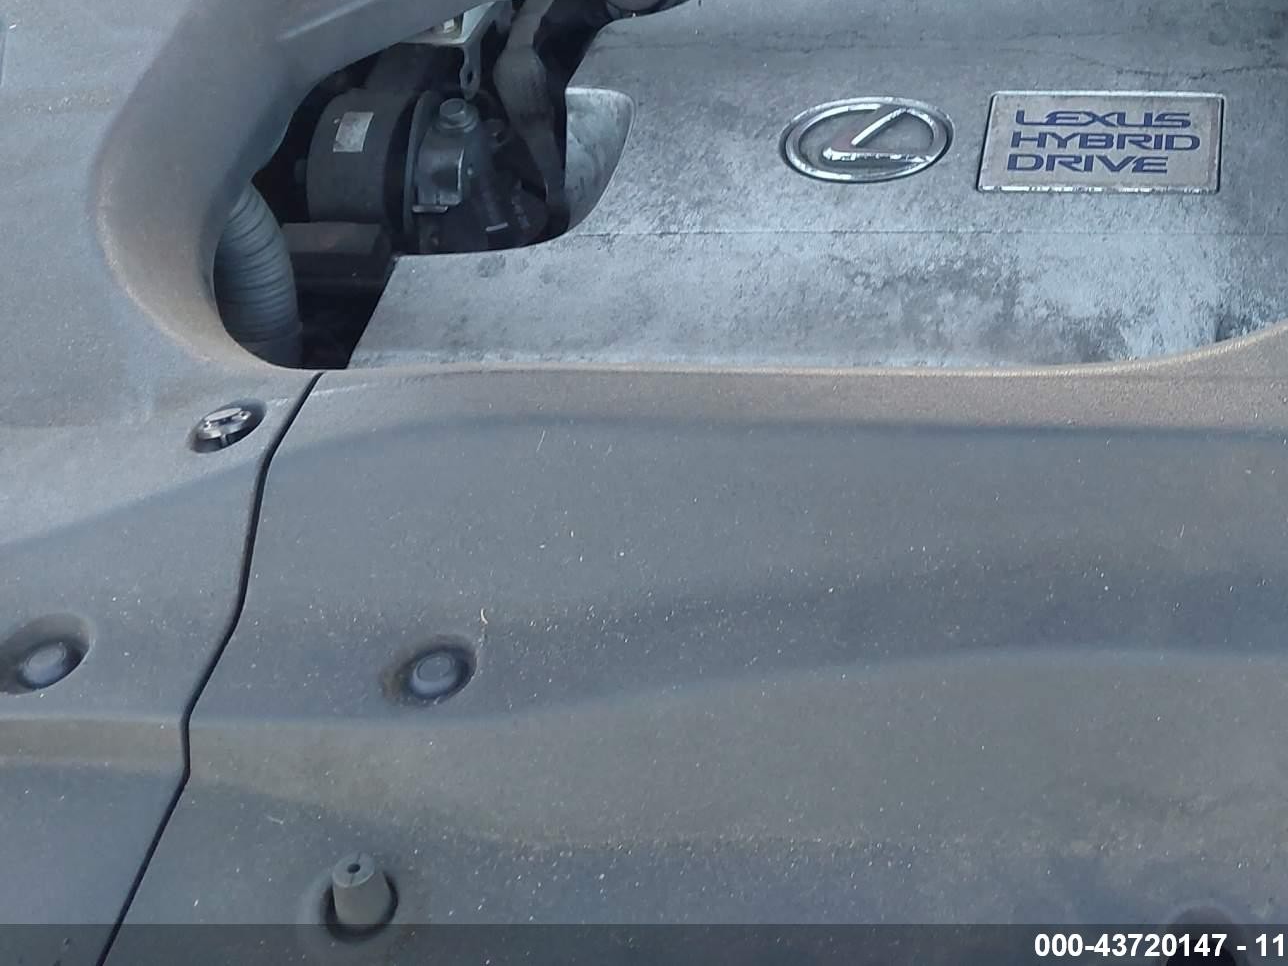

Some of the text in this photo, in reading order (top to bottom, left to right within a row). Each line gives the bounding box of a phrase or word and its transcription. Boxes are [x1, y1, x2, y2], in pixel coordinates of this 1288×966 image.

[1015, 110, 1192, 129] LEXUS
[1010, 132, 1201, 151] HYBRID
[1006, 153, 1169, 174] DRIVE
